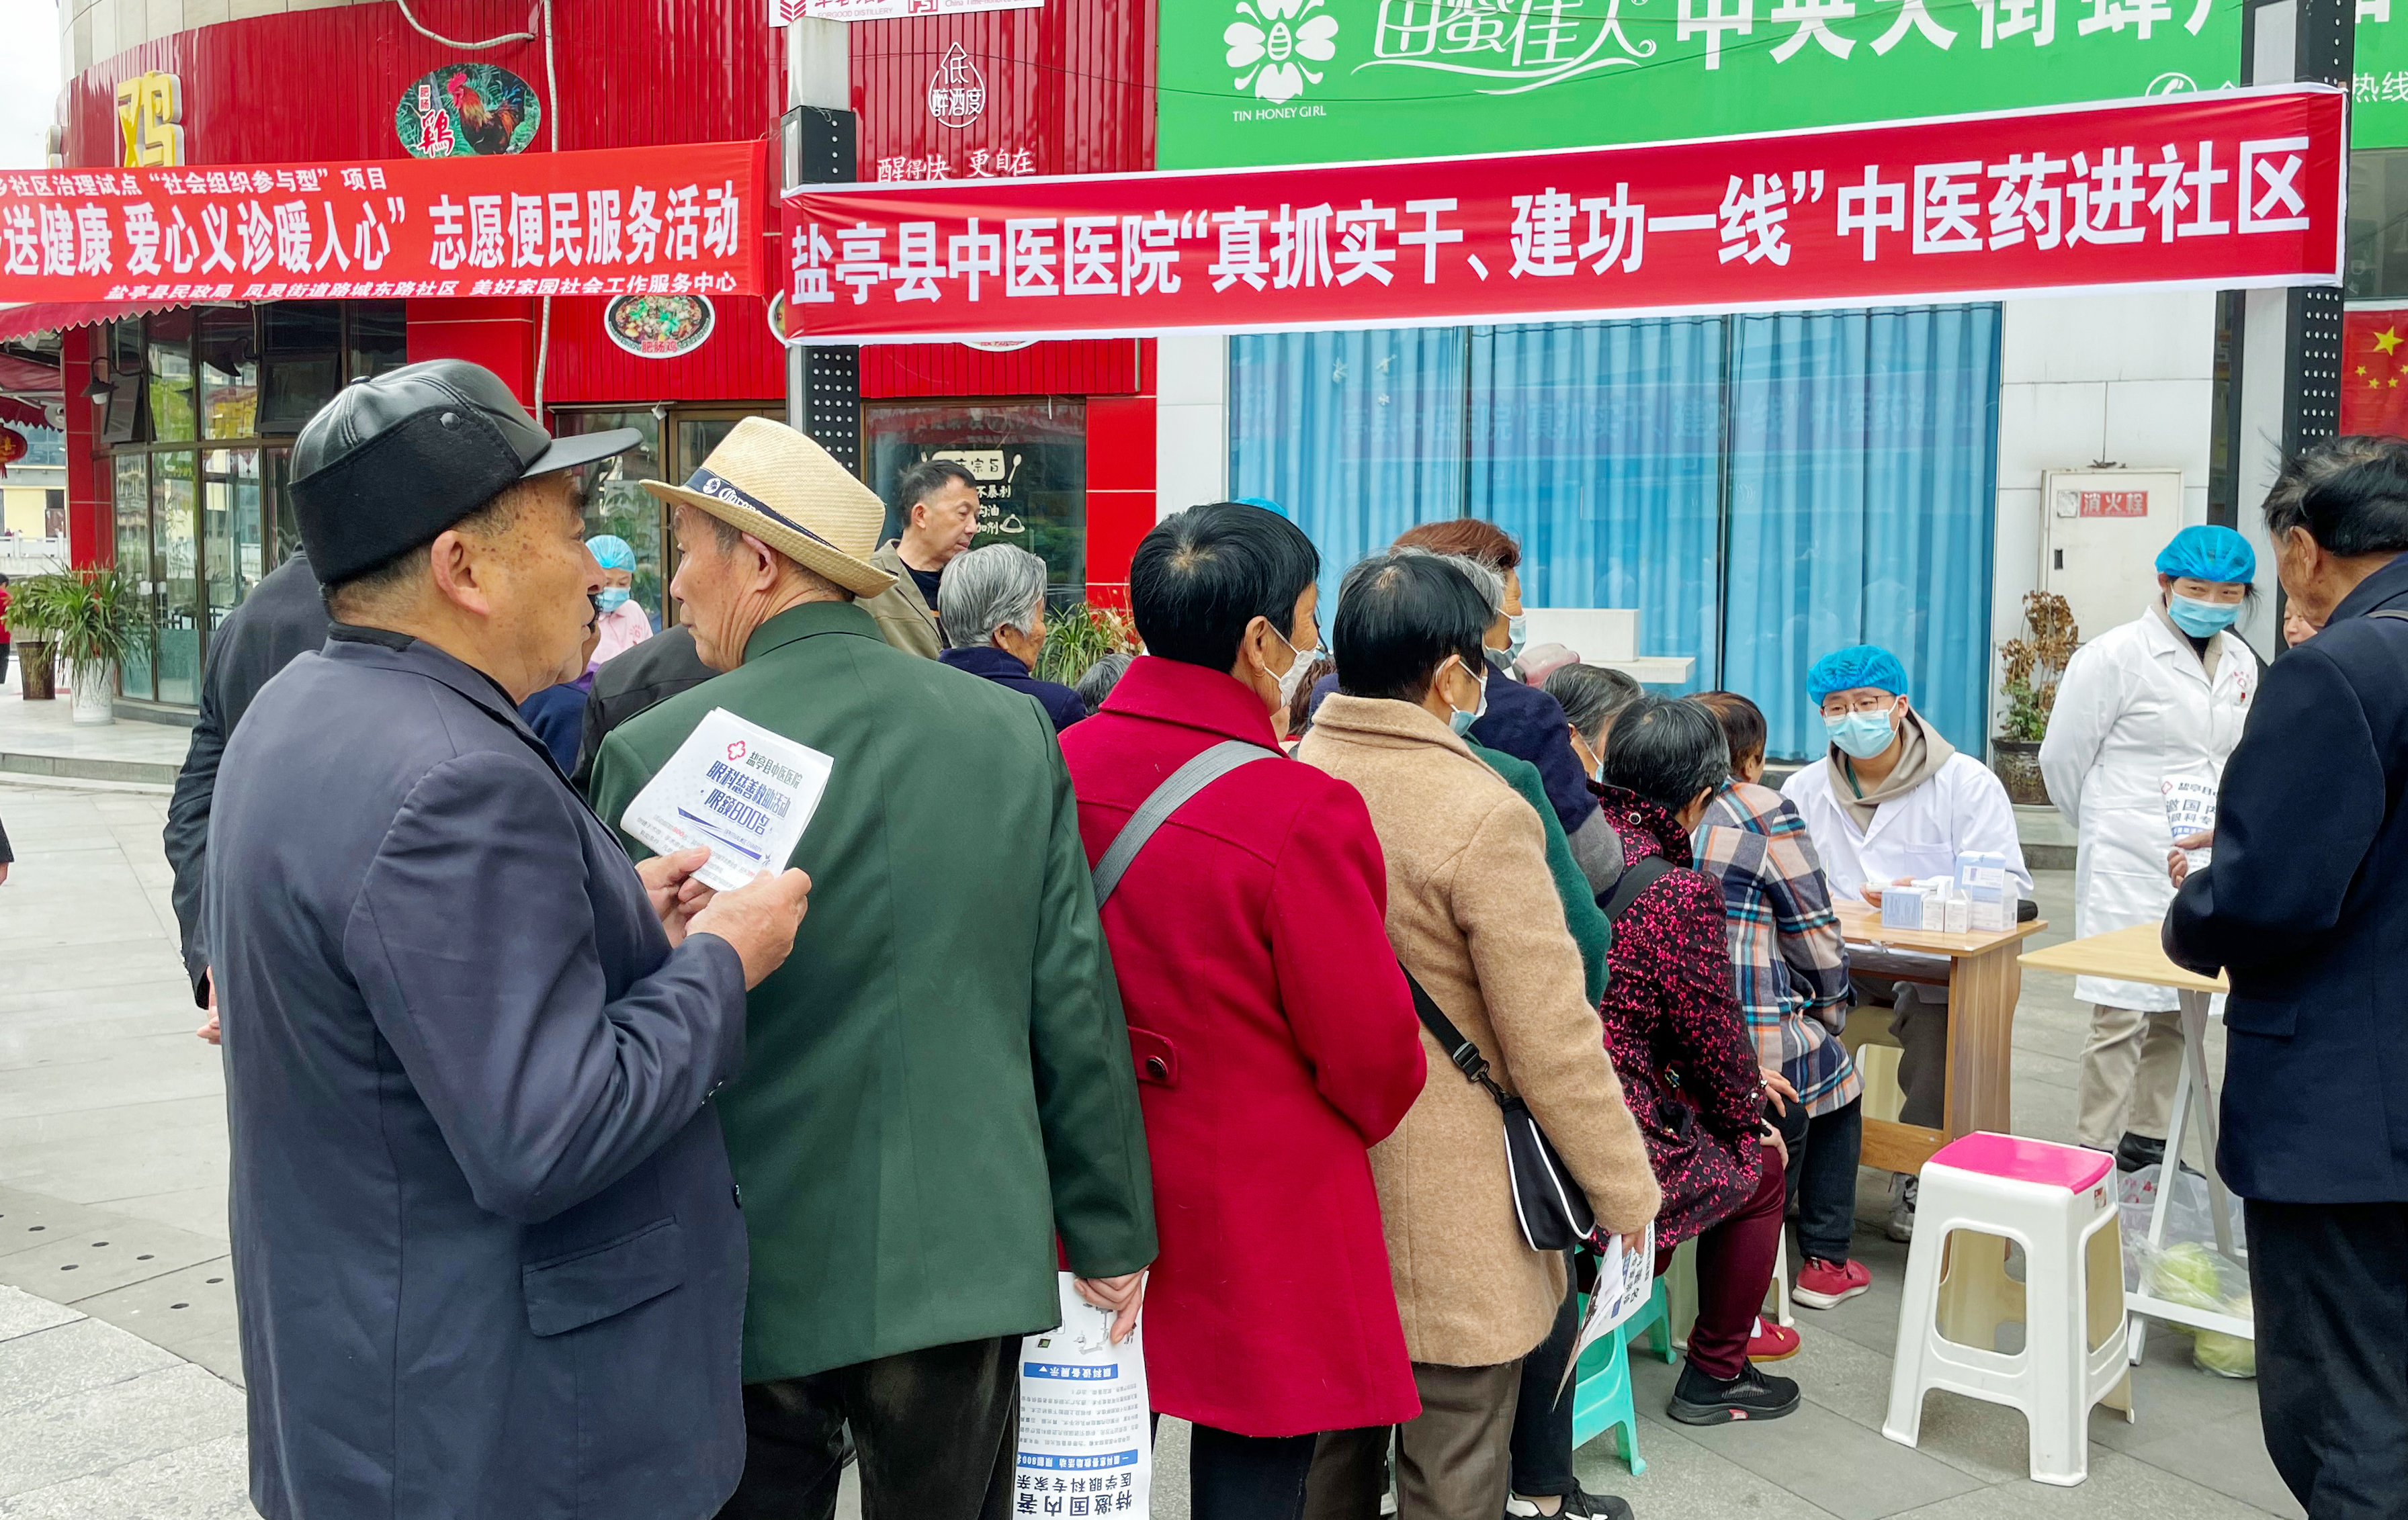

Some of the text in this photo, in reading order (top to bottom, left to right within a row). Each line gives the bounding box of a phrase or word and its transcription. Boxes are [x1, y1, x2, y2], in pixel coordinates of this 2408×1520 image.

[855, 7, 893, 16] DISTILLERY
[118, 70, 185, 168] 鸡
[1232, 105, 1327, 122] TIN HONEY GIRL
[341, 167, 388, 192] 项目
[877, 147, 1036, 183] 醒得快 更自在
[429, 179, 740, 271] 志愿便民服务活动
[104, 283, 234, 300] 盐亭县民政局
[469, 271, 737, 296] 美好家园社会工作服务中心
[642, 340, 677, 353] 肥肠鸡
[2083, 492, 2143, 512] 消火栓
[745, 750, 804, 789] 盐亭县中医医院
[705, 760, 791, 819] 眼科慈善救助活动
[703, 788, 771, 836] 限额800名
[1017, 1490, 1133, 1517] 特邀国内著
